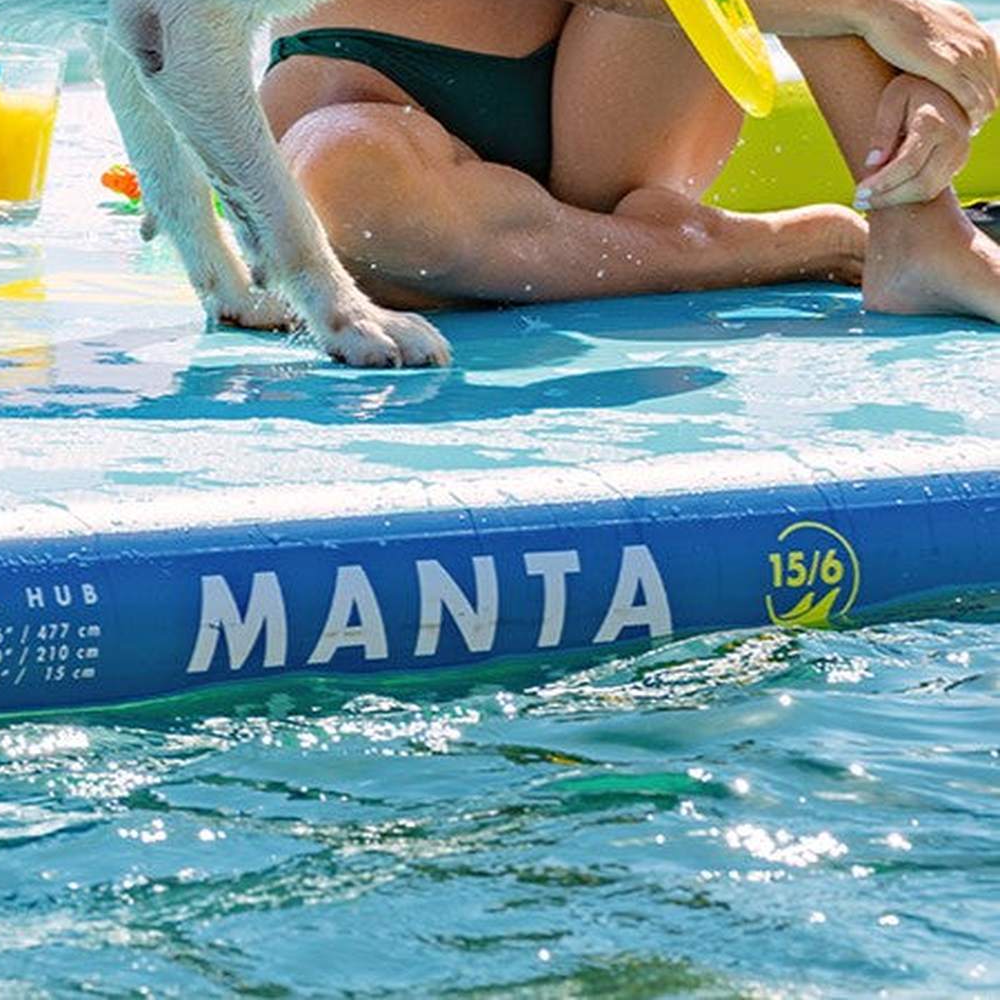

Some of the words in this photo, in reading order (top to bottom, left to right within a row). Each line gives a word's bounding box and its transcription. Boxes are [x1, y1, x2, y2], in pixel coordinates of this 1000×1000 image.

[769, 549, 844, 588] 15/6
[25, 583, 98, 608] HUB
[187, 545, 673, 673] MANTA
[37, 623, 69, 639] 477
[77, 624, 100, 638] cm
[36, 645, 68, 662] 210
[76, 647, 99, 659] cm
[45, 666, 65, 681] 15
[72, 667, 95, 680] cm
